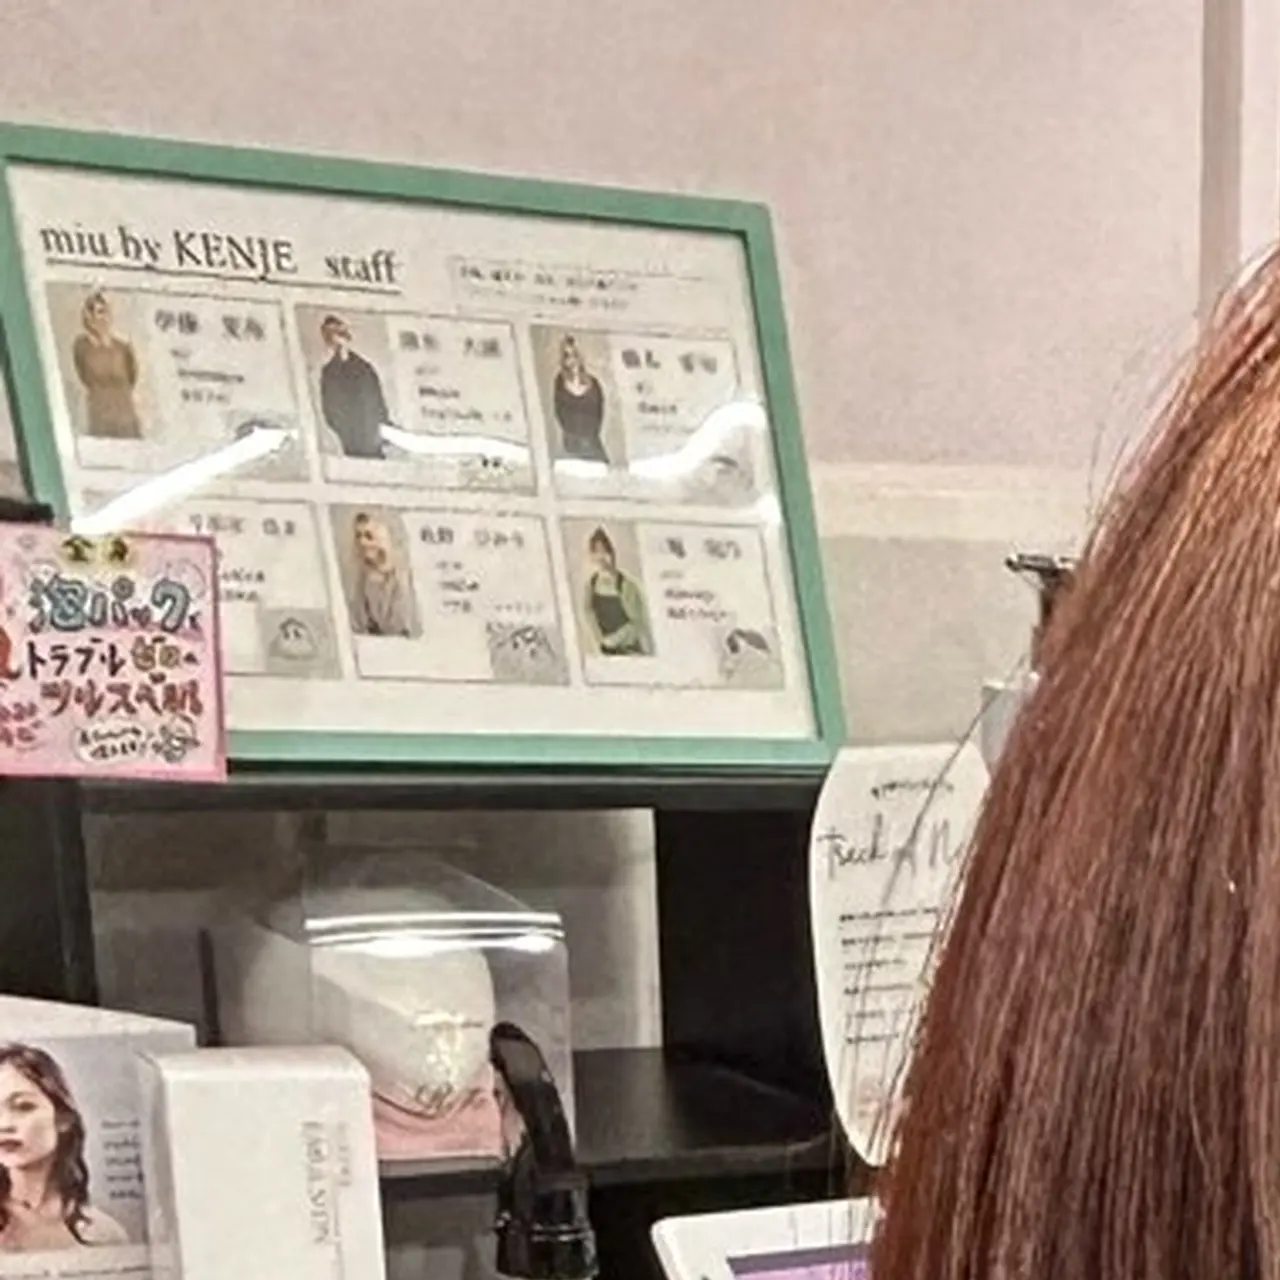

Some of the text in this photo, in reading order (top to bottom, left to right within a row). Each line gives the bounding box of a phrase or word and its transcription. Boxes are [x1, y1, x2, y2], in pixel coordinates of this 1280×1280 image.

[40, 223, 402, 284] miu by KENJE staff
